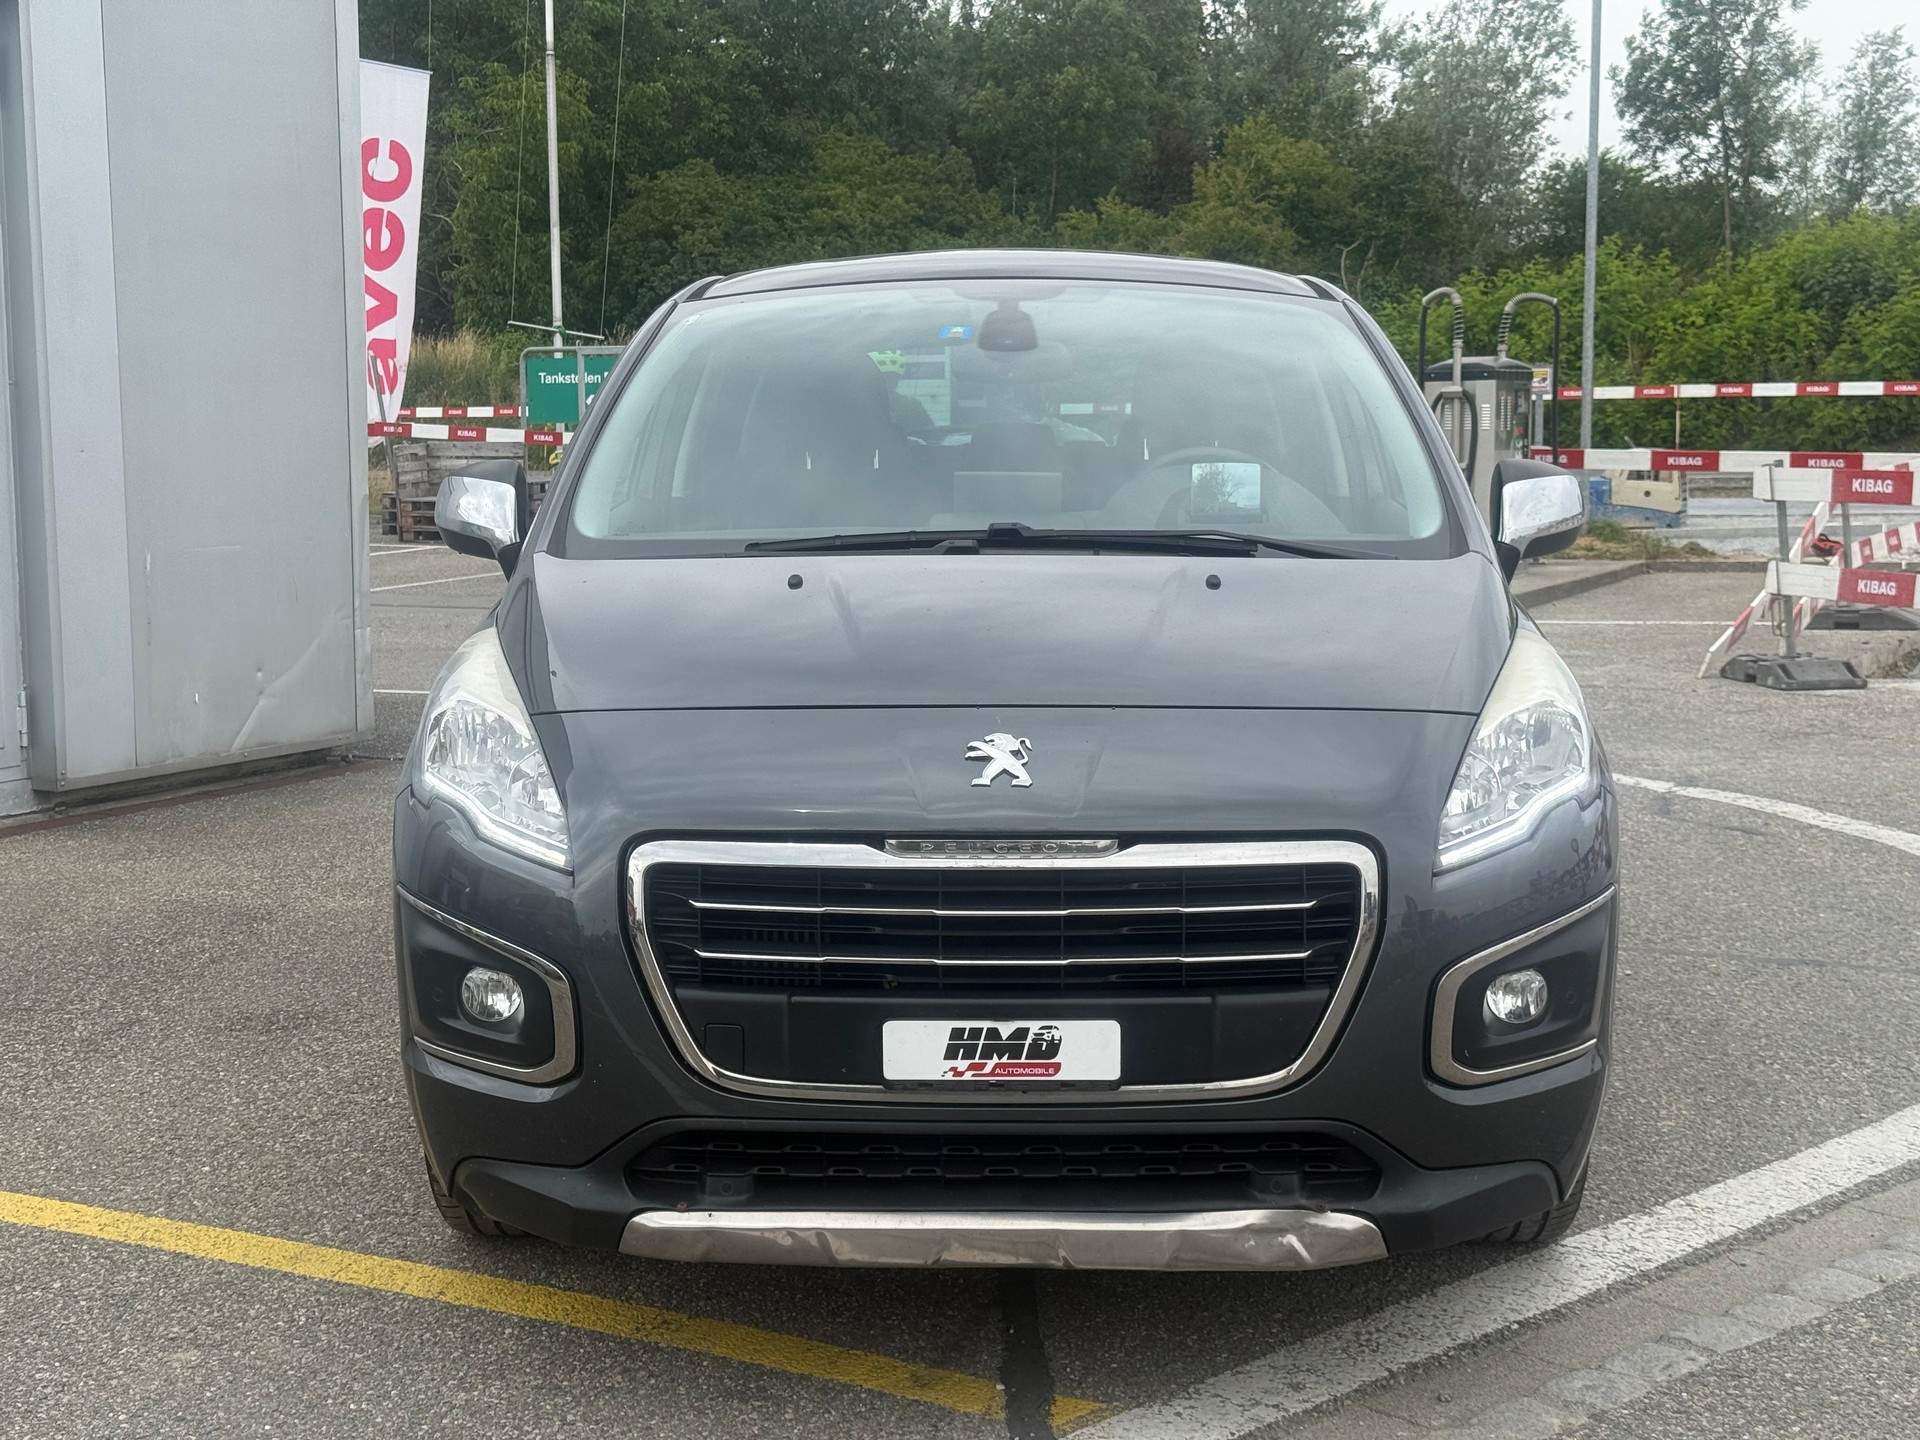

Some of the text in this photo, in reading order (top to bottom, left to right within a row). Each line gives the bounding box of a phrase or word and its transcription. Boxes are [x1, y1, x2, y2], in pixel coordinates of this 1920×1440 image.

[361, 137, 412, 396] avec
[538, 372, 601, 384] Tankstlen
[1720, 386, 1744, 394] KIBAG
[1806, 385, 1830, 393] KIBAG
[1894, 384, 1918, 392] KIBAG
[457, 430, 477, 438] KIBAG
[533, 434, 554, 442] KIBAG
[1534, 454, 1568, 464] KIBG
[1667, 456, 1703, 466] KIBAG
[1807, 458, 1846, 468] KIBAG
[1852, 478, 1893, 493] KIBAG
[1857, 579, 1897, 596] KIBAG
[920, 842, 1081, 853] PEUGEOT
[943, 1025, 1062, 1061] HMD
[994, 1067, 1055, 1075] AUTOMOBILE
